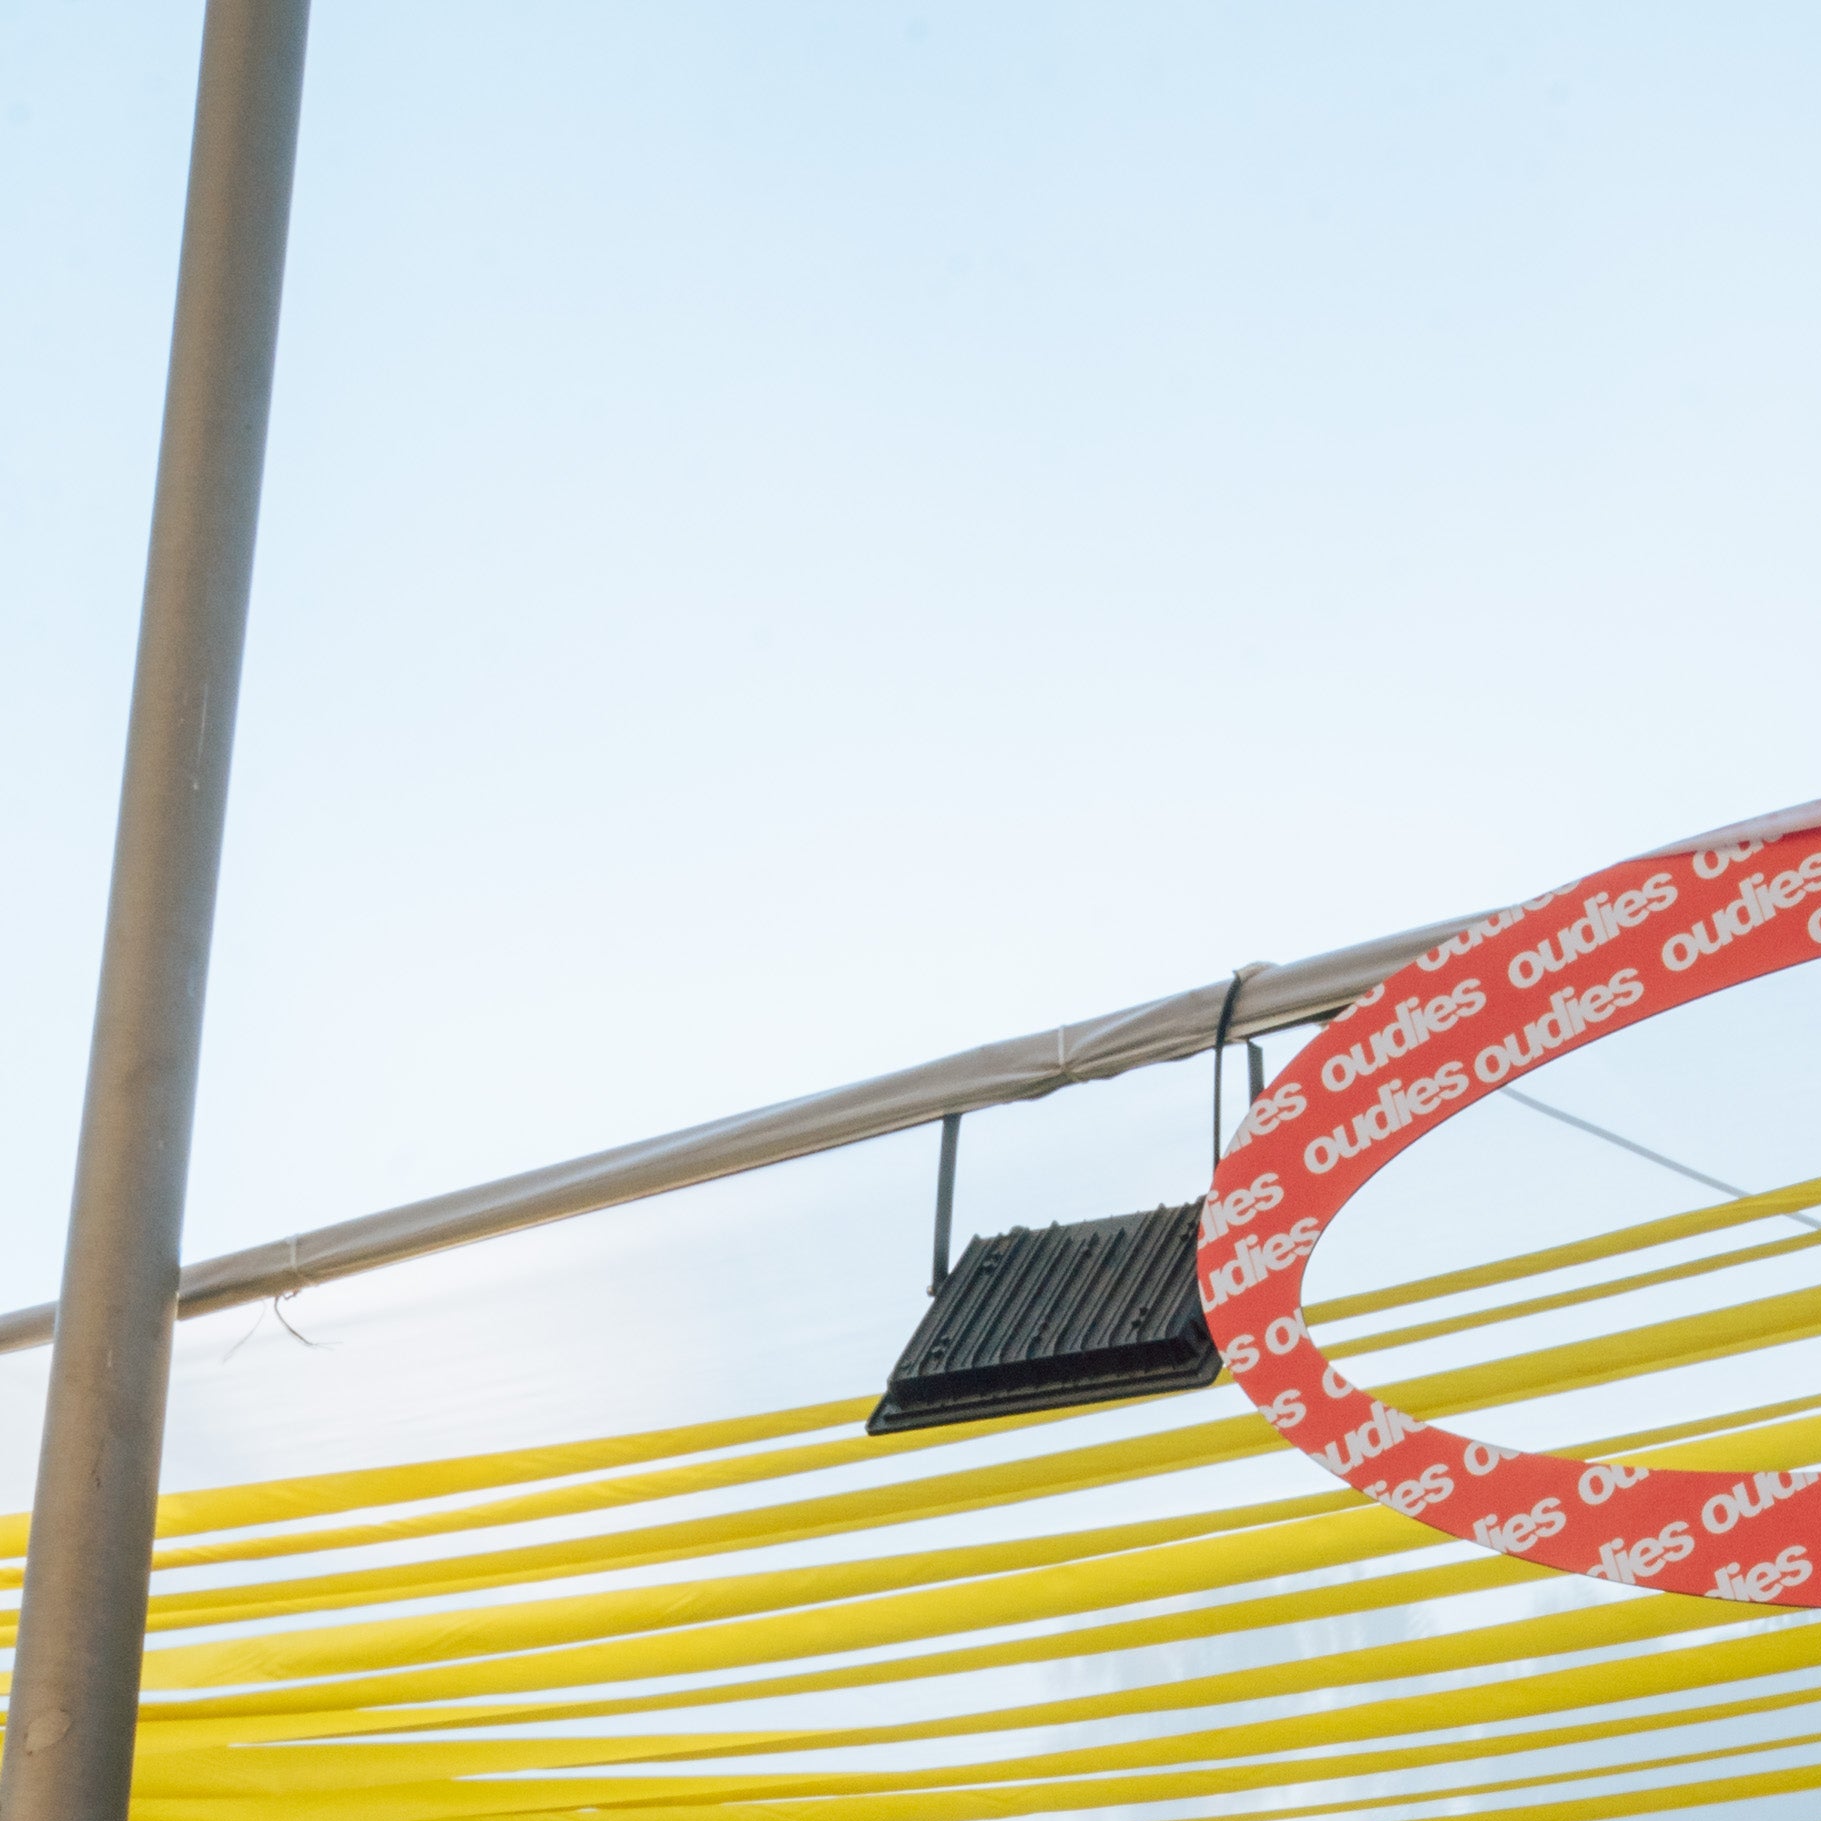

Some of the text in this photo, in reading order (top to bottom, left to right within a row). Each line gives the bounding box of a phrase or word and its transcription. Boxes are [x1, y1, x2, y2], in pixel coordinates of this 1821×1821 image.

[1508, 873, 1679, 989] oudies
[1321, 978, 1487, 1092] oudies
[1474, 967, 1645, 1083] oudies
[1304, 1061, 1469, 1174] oudies
[1200, 1216, 1321, 1314] udies
